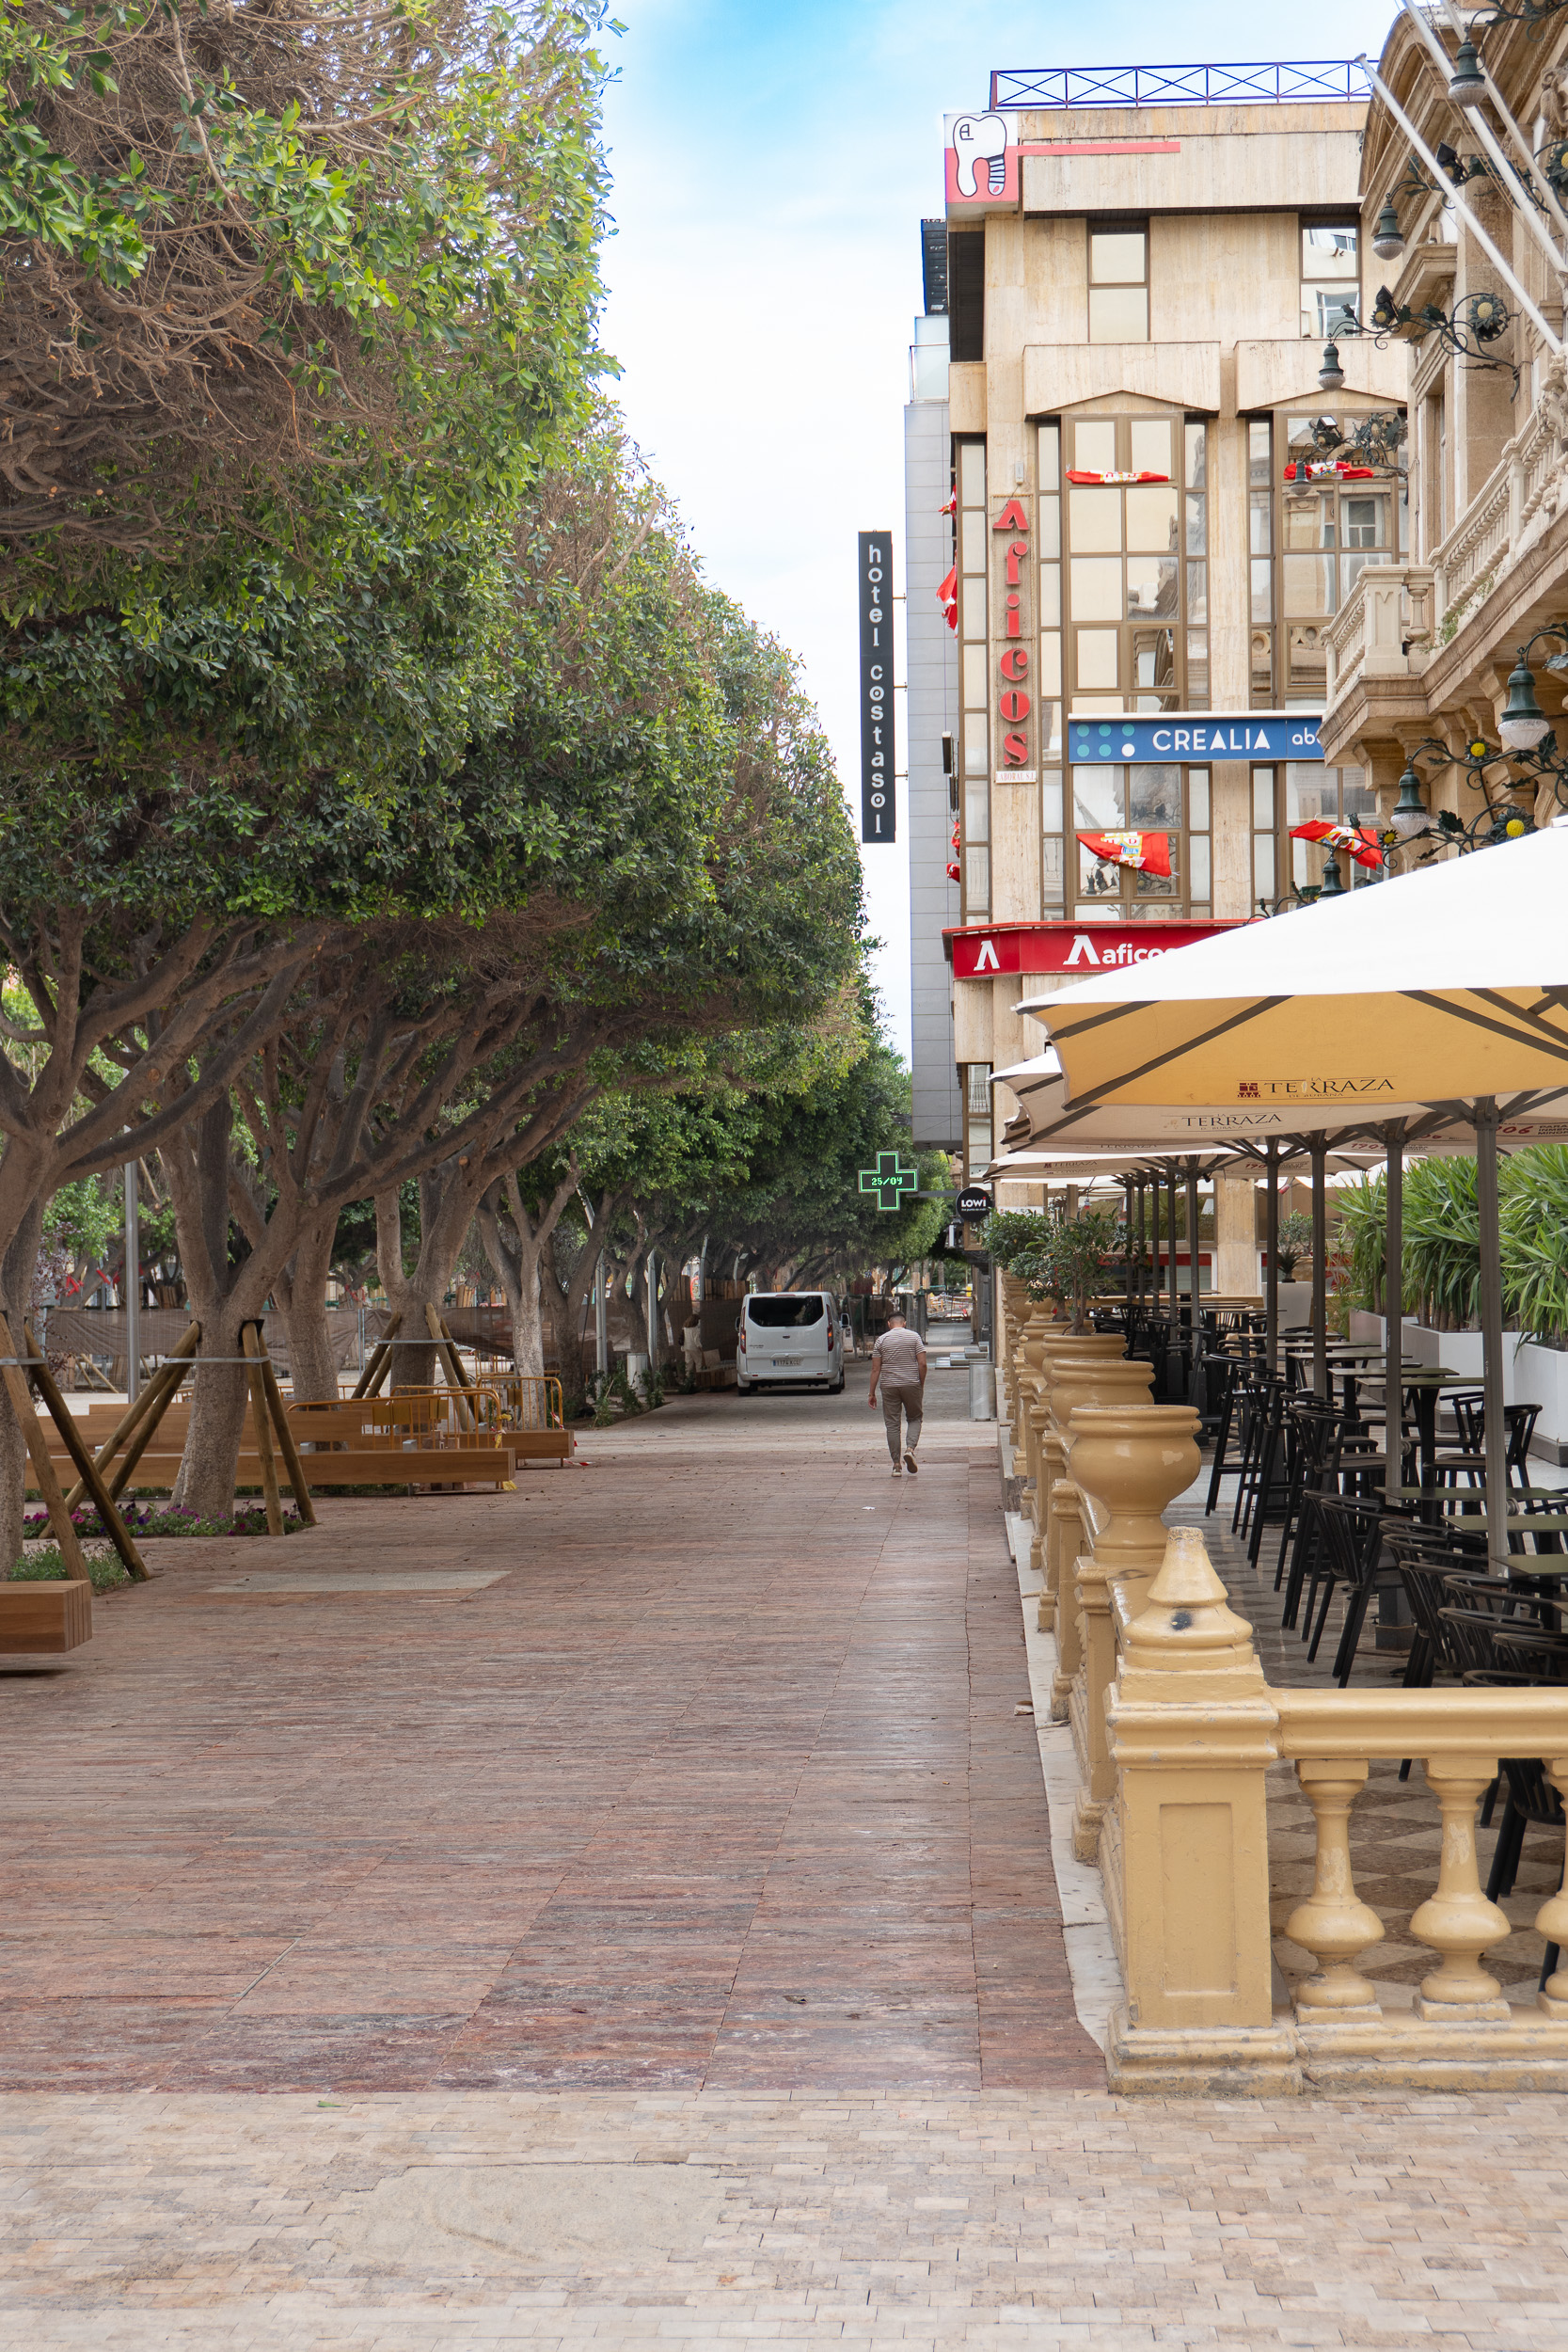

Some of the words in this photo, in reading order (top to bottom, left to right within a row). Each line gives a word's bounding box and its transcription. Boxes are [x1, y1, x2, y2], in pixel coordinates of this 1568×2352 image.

[867, 544, 883, 647] hotel
[992, 500, 1031, 766] Aficos
[870, 663, 886, 834] costasol
[1152, 728, 1271, 751] CREALIA
[1291, 726, 1322, 746] ab
[1263, 1078, 1395, 1094] TERRAZA
[1181, 1113, 1283, 1127] TERRAZA
